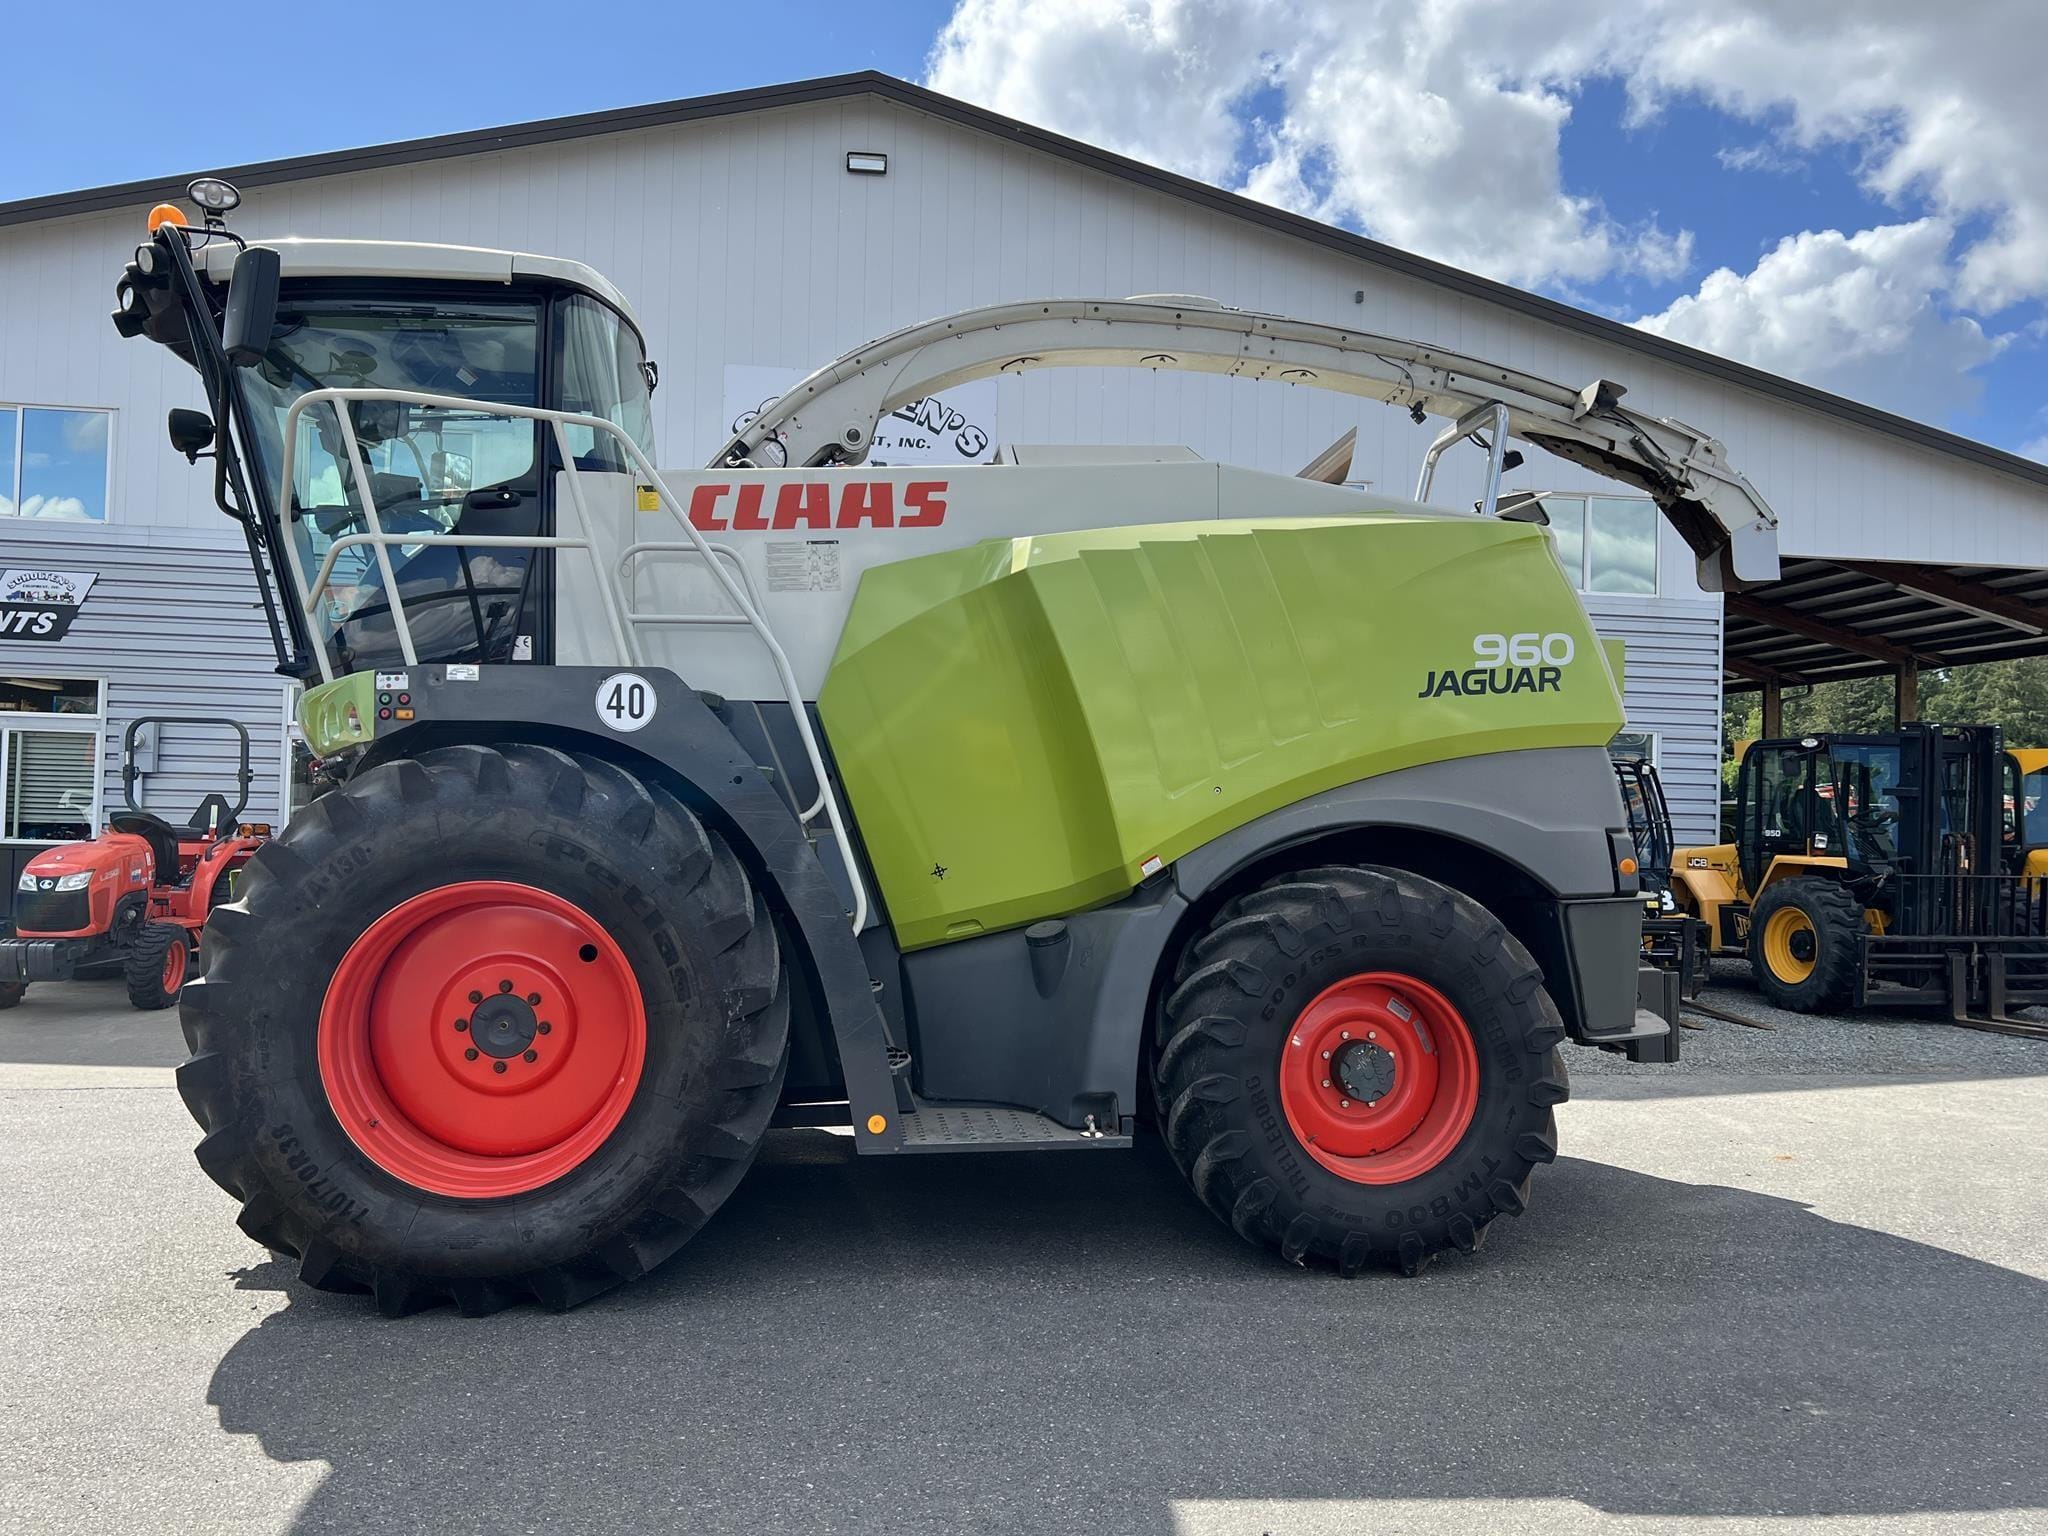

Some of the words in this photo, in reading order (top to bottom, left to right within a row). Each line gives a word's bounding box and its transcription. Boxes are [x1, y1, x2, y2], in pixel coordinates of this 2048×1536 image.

[899, 437, 931, 449] INC.
[688, 481, 949, 531] CLAAS
[7, 572, 76, 591] SCHOLTEN'S
[1473, 633, 1575, 668] 960
[1418, 667, 1562, 698] JAGUAR
[606, 683, 645, 720] 40
[1688, 857, 1708, 867] JCB
[1246, 1075, 1311, 1195] TRELLEBORG
